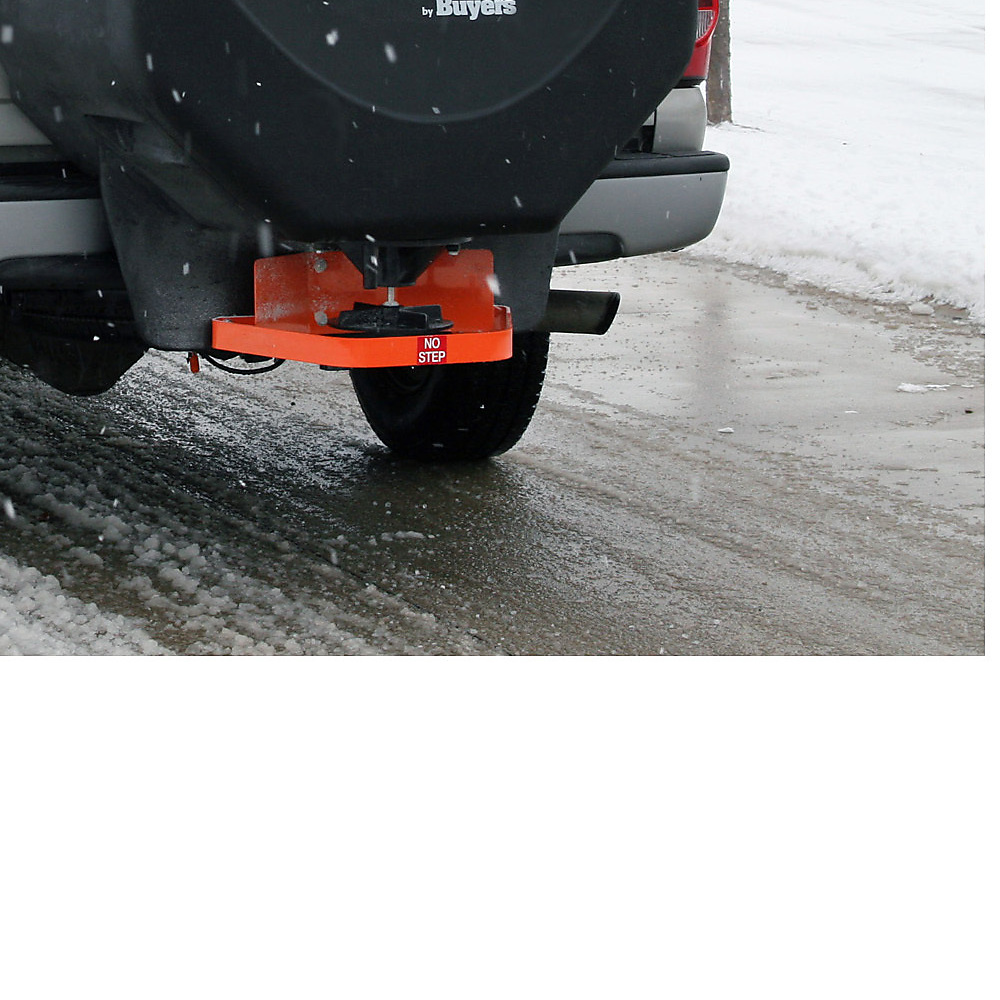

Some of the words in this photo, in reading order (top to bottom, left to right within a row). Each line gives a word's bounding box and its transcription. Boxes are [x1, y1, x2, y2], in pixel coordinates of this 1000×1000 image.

[422, 6, 434, 18] by
[424, 337, 441, 349] NO
[418, 351, 446, 363] STEP
